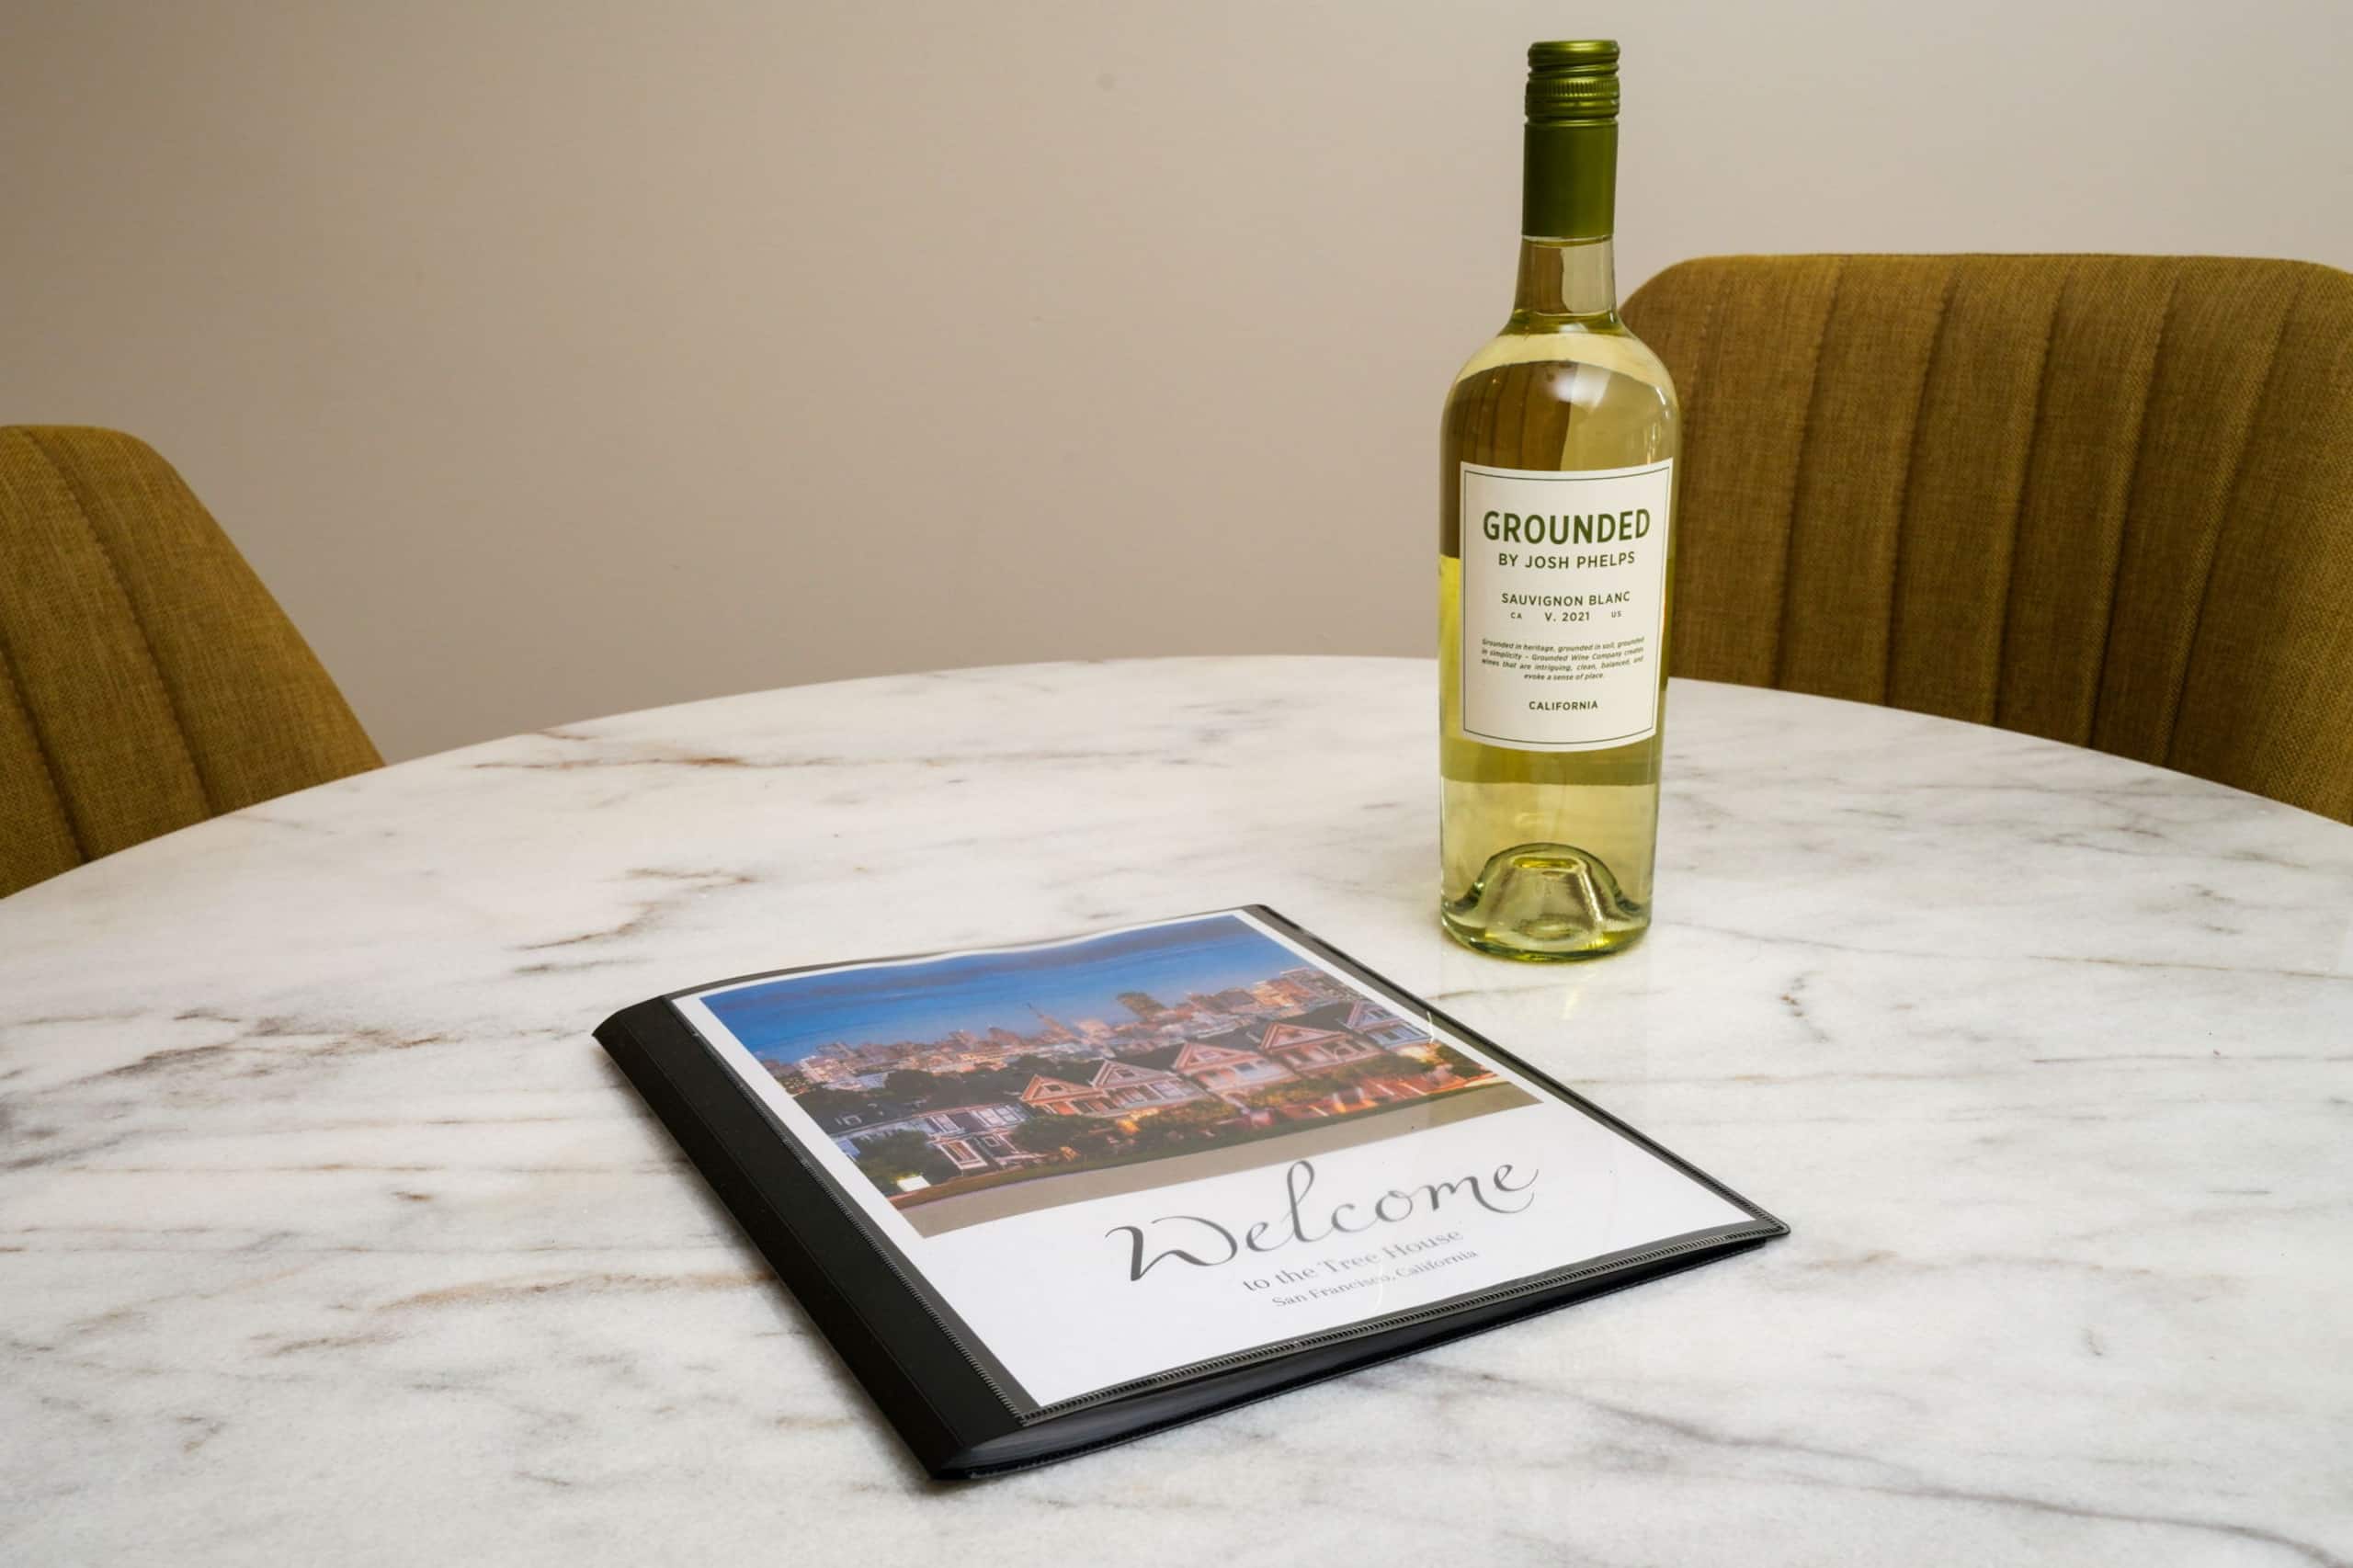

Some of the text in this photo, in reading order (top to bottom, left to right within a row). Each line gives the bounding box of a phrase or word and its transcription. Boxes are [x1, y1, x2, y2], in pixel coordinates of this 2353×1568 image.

[1483, 508, 1651, 544] GROUNDED
[1498, 551, 1635, 569] BY JOSH PHELPS
[1502, 591, 1631, 607] SAUVIGNON BLANC
[1545, 612, 1556, 622] V.
[1562, 611, 1590, 622] 2021
[1481, 638, 1515, 649] Grounded
[1558, 643, 1594, 653] grounded
[1489, 650, 1522, 660] simplicity
[1592, 651, 1622, 661] Company
[1529, 700, 1598, 710] CALIFORNIA
[1104, 1159, 1540, 1282] Welcome
[1243, 1230, 1464, 1292] to the Tree House
[1272, 1248, 1479, 1308] San Francisco, California
